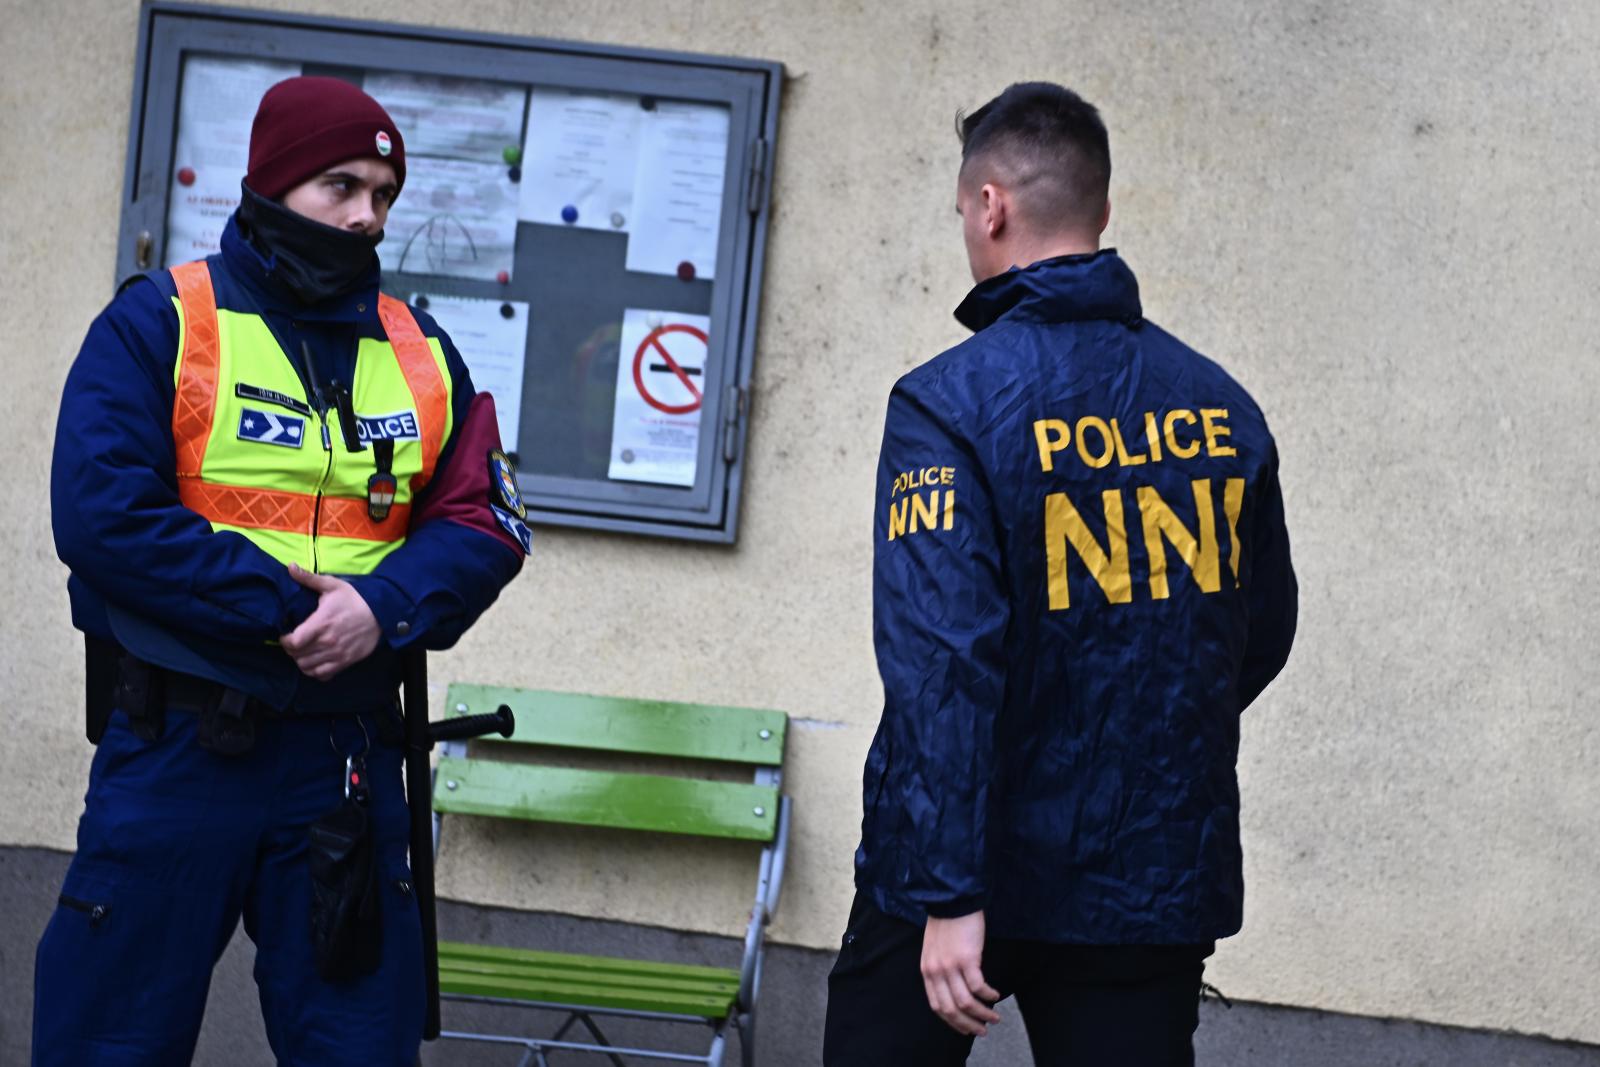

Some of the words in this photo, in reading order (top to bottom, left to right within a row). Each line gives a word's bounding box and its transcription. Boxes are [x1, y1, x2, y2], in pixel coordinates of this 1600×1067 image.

[355, 415, 417, 440] OLICE
[1034, 408, 1237, 473] POLICE
[892, 467, 955, 498] POLICE
[888, 490, 955, 541] NNI
[1045, 479, 1245, 610] NNI
